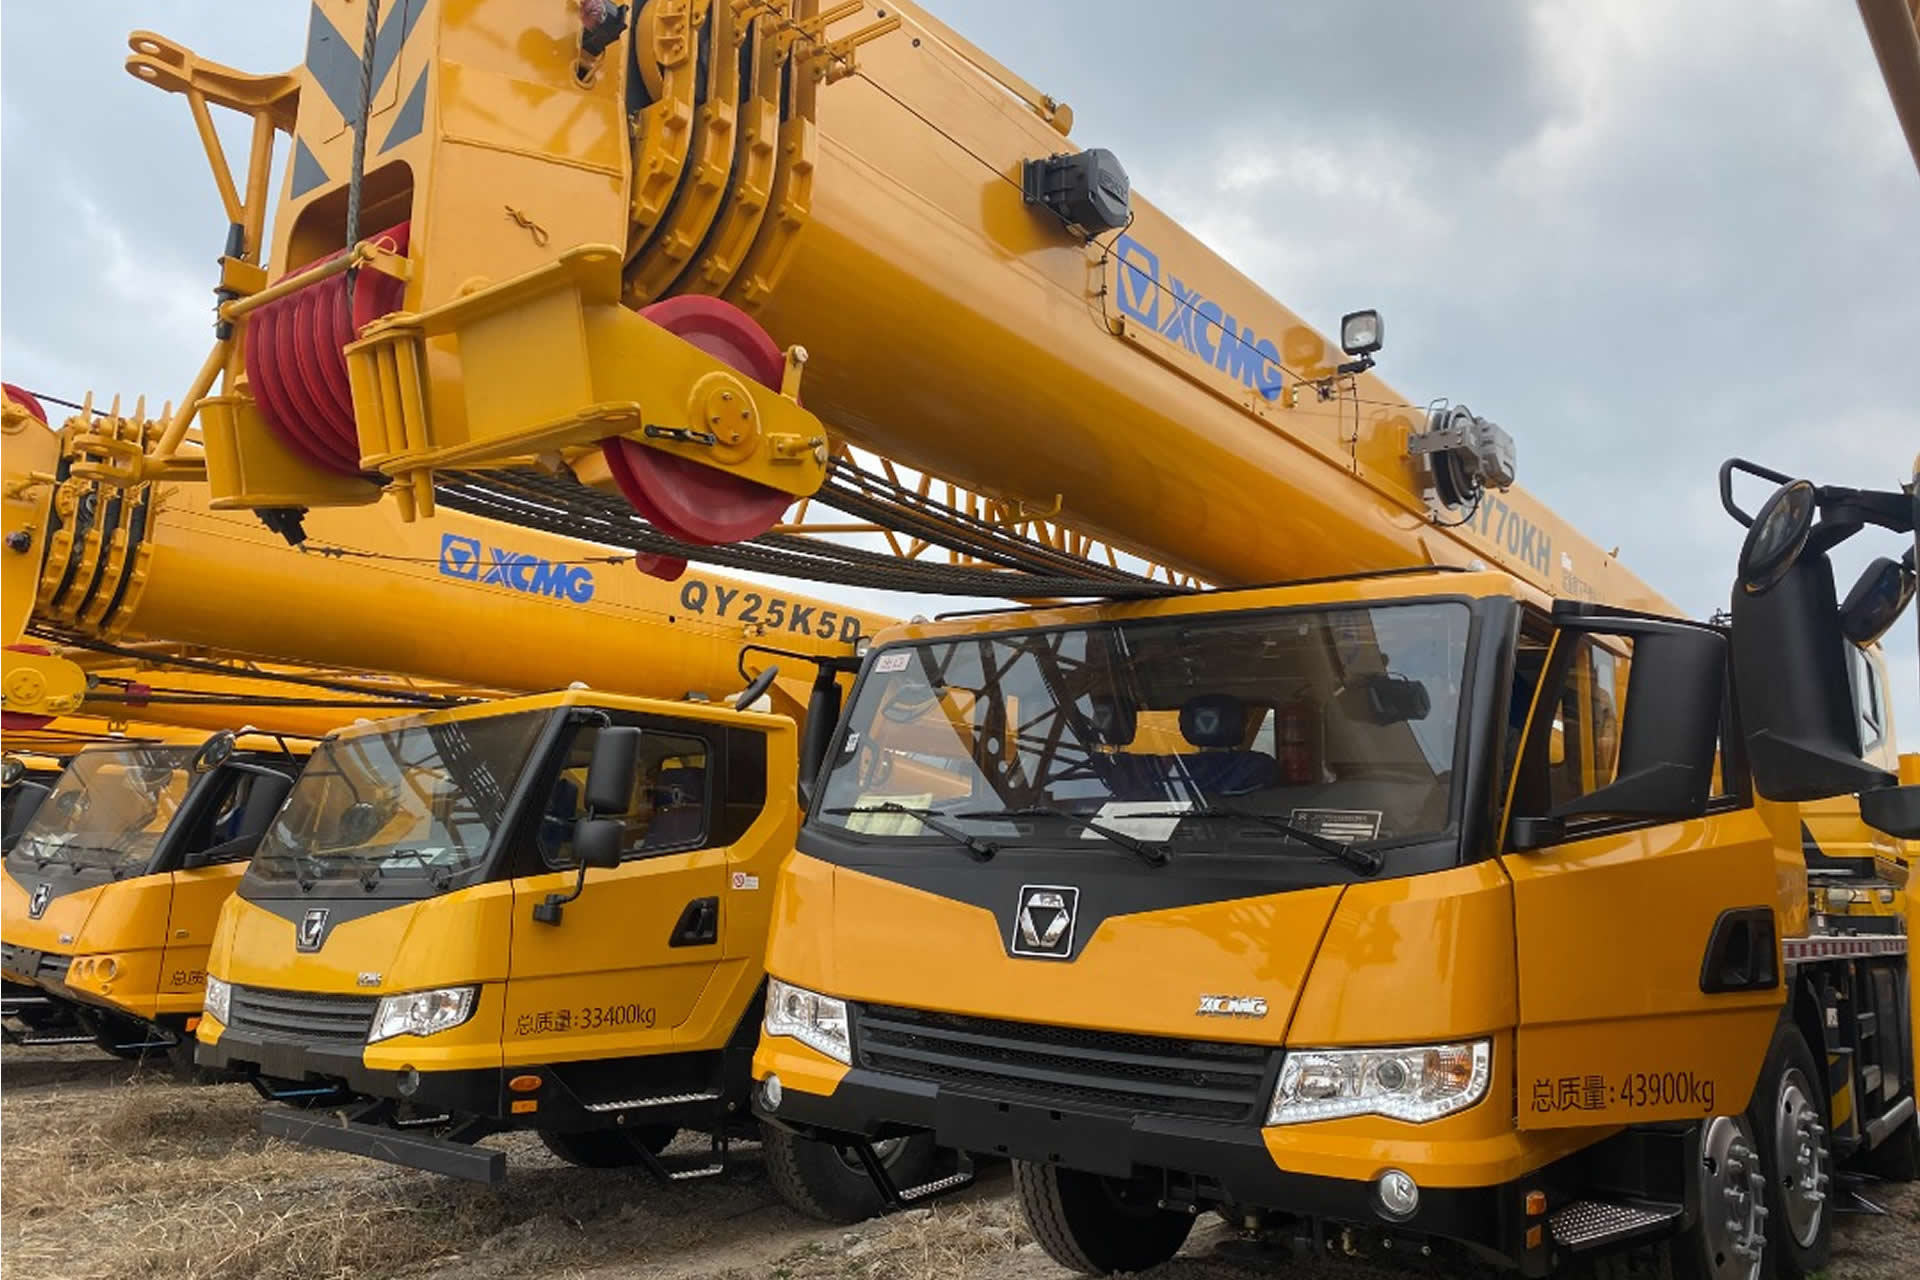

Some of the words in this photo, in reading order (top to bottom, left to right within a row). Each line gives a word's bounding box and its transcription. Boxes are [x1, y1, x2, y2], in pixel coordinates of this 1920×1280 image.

[1160, 273, 1283, 400] XCMG
[479, 547, 594, 603] XCMG
[680, 580, 861, 643] QY25K5D
[1531, 1071, 1715, 1113] 总质量:43900kg
